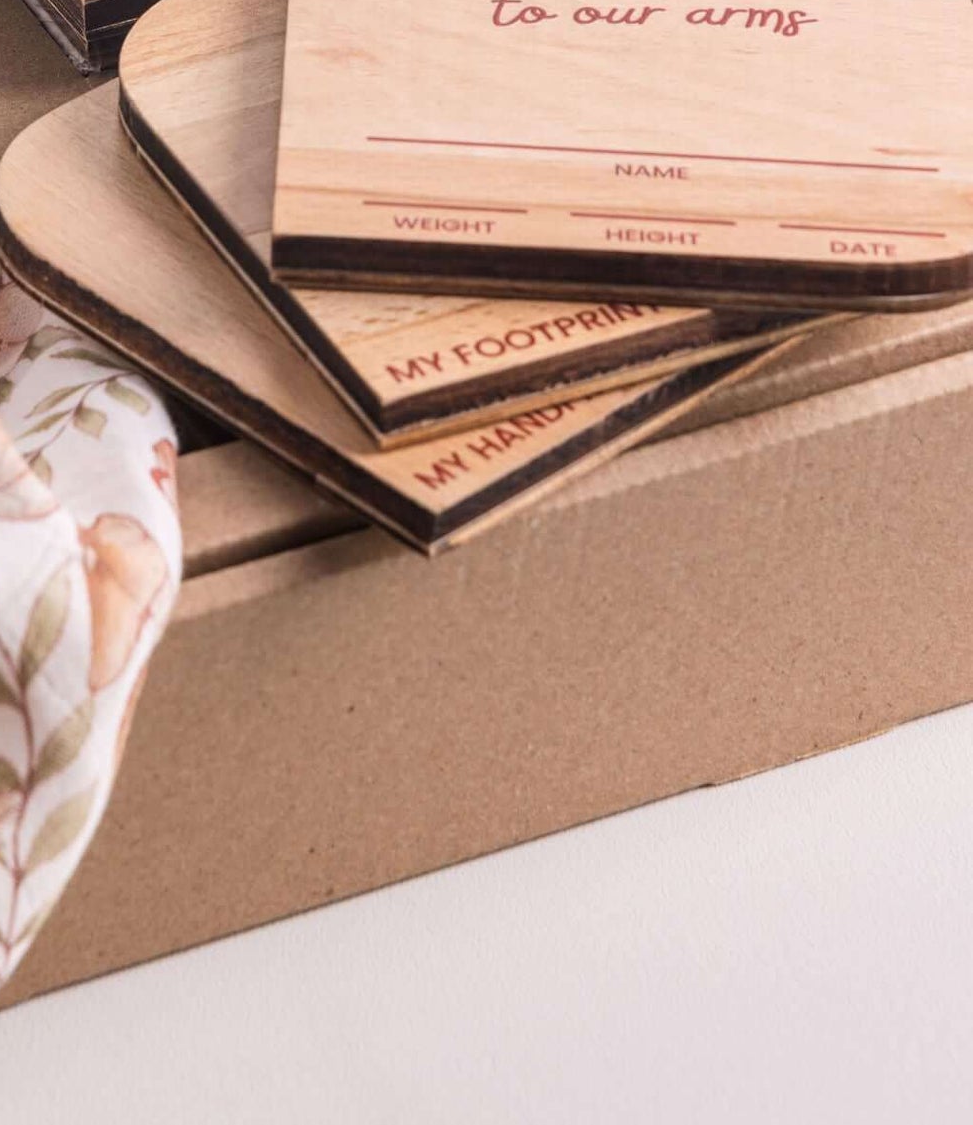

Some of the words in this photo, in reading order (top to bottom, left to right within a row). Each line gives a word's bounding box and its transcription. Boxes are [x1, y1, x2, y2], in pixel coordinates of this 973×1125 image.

[572, 4, 666, 25] our
[685, 4, 819, 37] arms
[614, 163, 690, 180] NAME
[393, 217, 496, 234] WEIGHT
[605, 228, 701, 246] HEIGHT
[830, 240, 897, 258] DATE
[385, 352, 443, 383] MY
[414, 451, 470, 490] MY
